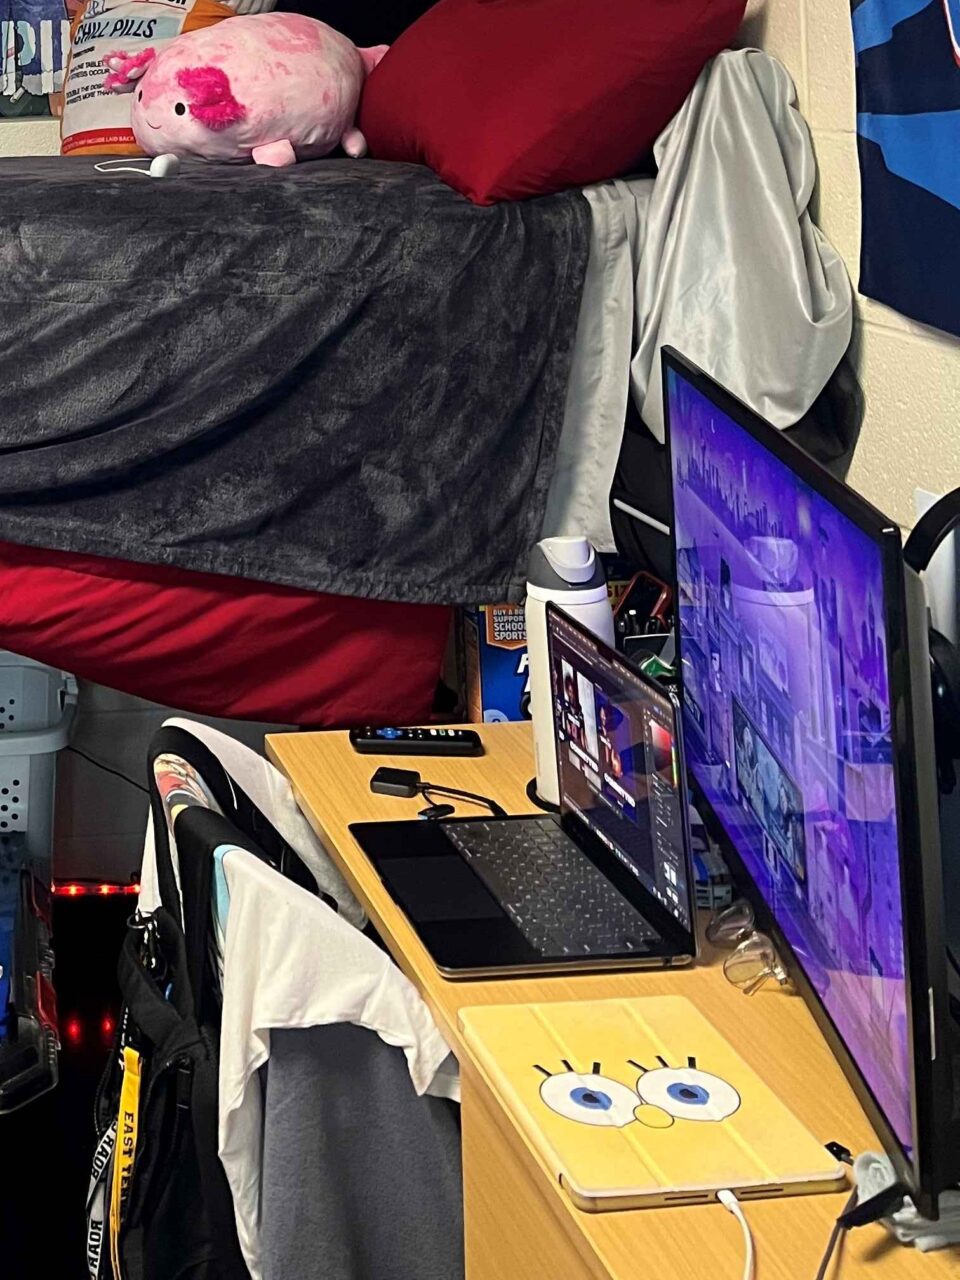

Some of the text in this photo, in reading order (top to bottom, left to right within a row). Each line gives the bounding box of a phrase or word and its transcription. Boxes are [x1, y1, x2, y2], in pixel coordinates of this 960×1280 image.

[74, 19, 157, 45] CHILL PILLS
[493, 615, 525, 623] SUPPOR
[494, 622, 527, 631] SCHOO
[123, 1110, 134, 1158] EAST
